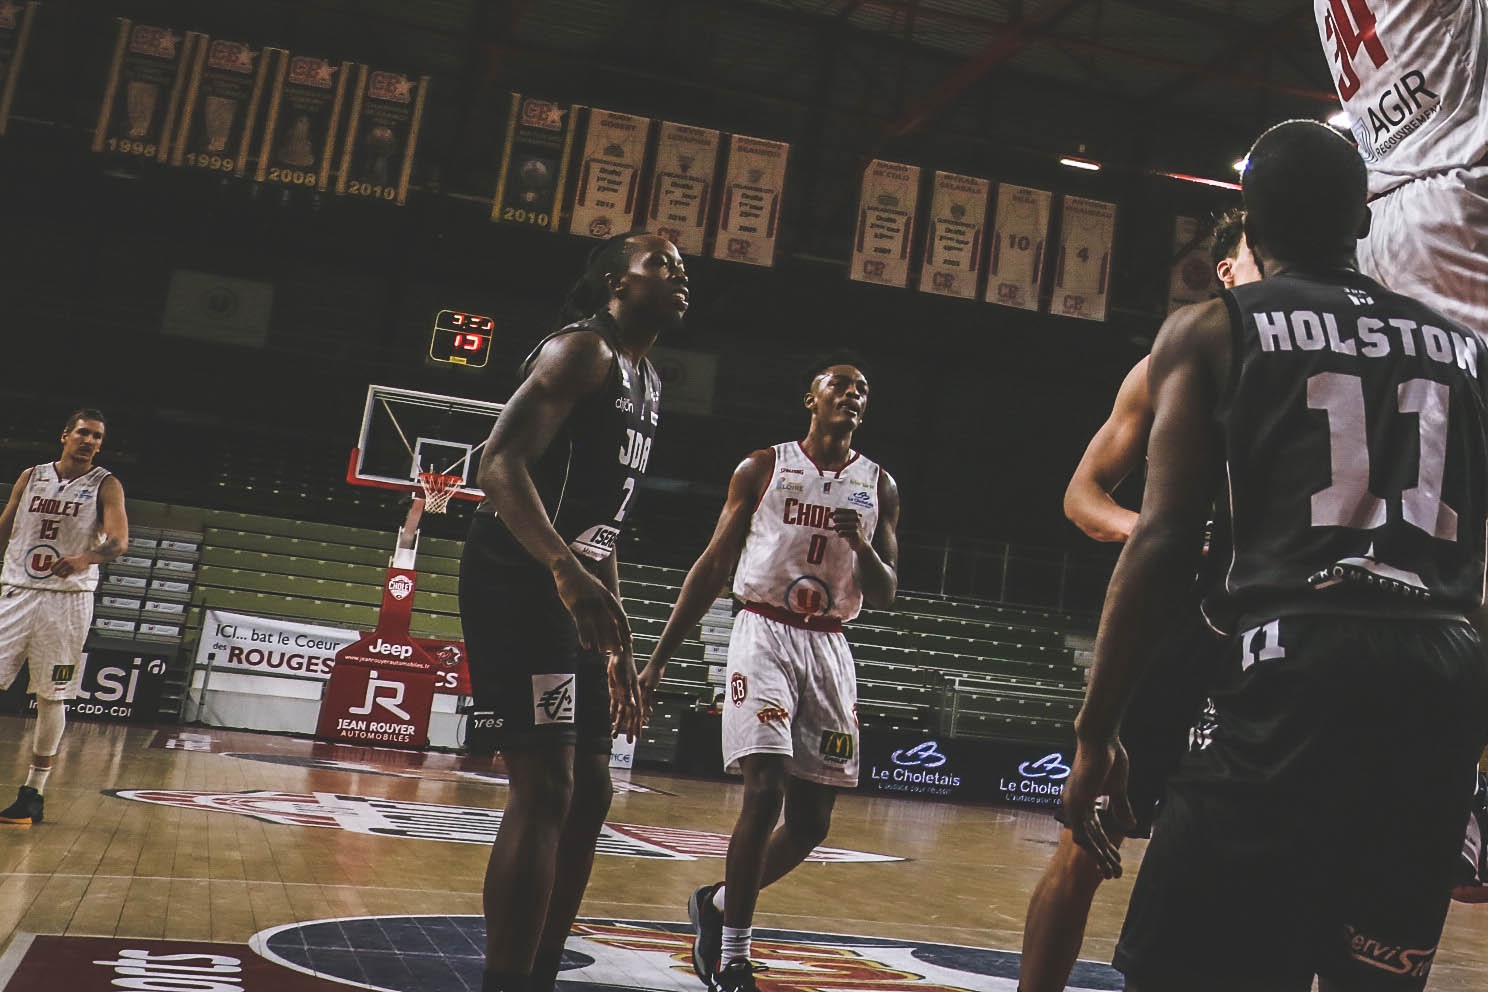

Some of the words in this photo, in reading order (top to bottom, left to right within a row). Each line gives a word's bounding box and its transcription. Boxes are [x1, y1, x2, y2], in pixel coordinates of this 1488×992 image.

[1367, 69, 1439, 143] AGIR
[107, 138, 158, 158] 1998
[186, 153, 235, 172] 1999
[269, 168, 317, 187] 2008
[349, 181, 396, 201] 2010
[504, 207, 549, 227] 2010
[1009, 234, 1030, 251] 10
[1253, 310, 1478, 379] HOLSTON
[619, 428, 652, 474] JDA
[1307, 372, 1458, 543] 11
[28, 495, 83, 518] CHOLET
[614, 478, 635, 522] 2
[40, 519, 60, 540] 15
[806, 534, 828, 564] 0
[251, 629, 272, 643] bat
[278, 632, 290, 645] le
[295, 634, 341, 651] Coeur
[369, 639, 413, 659] Jeep
[1241, 619, 1285, 671] 11
[213, 642, 227, 651] des
[228, 646, 335, 675] ROUGES
[344, 654, 430, 669] www.jeanrouyerautomobiles.fr
[337, 718, 367, 732] JEAN
[370, 721, 415, 735] ROUYER
[341, 730, 409, 742] AUTOMOBILES
[872, 766, 889, 780] Le
[893, 768, 960, 786] Choletais
[1000, 778, 1016, 791] Le
